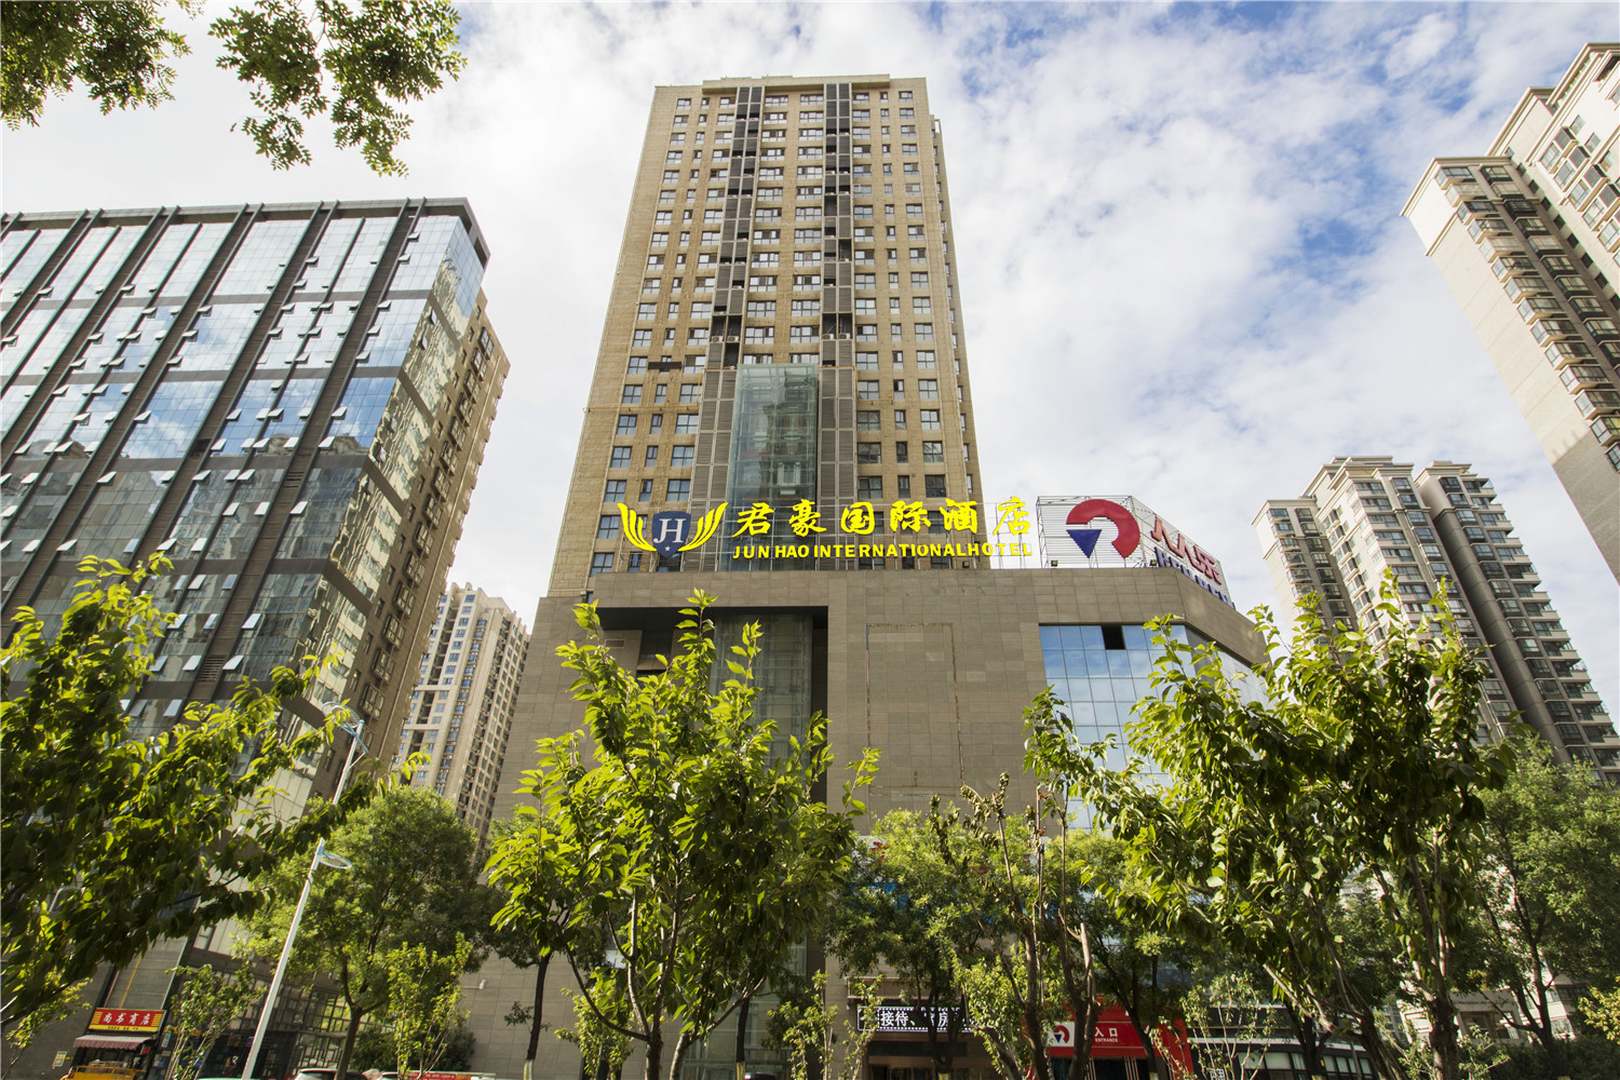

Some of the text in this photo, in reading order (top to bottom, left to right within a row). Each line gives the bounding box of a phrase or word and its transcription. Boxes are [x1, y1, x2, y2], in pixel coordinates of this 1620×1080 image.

[732, 495, 1031, 538] 君豪国际酒店
[732, 545, 769, 559] JUN
[775, 544, 810, 558] HAO
[1094, 1026, 1118, 1038] 入口
